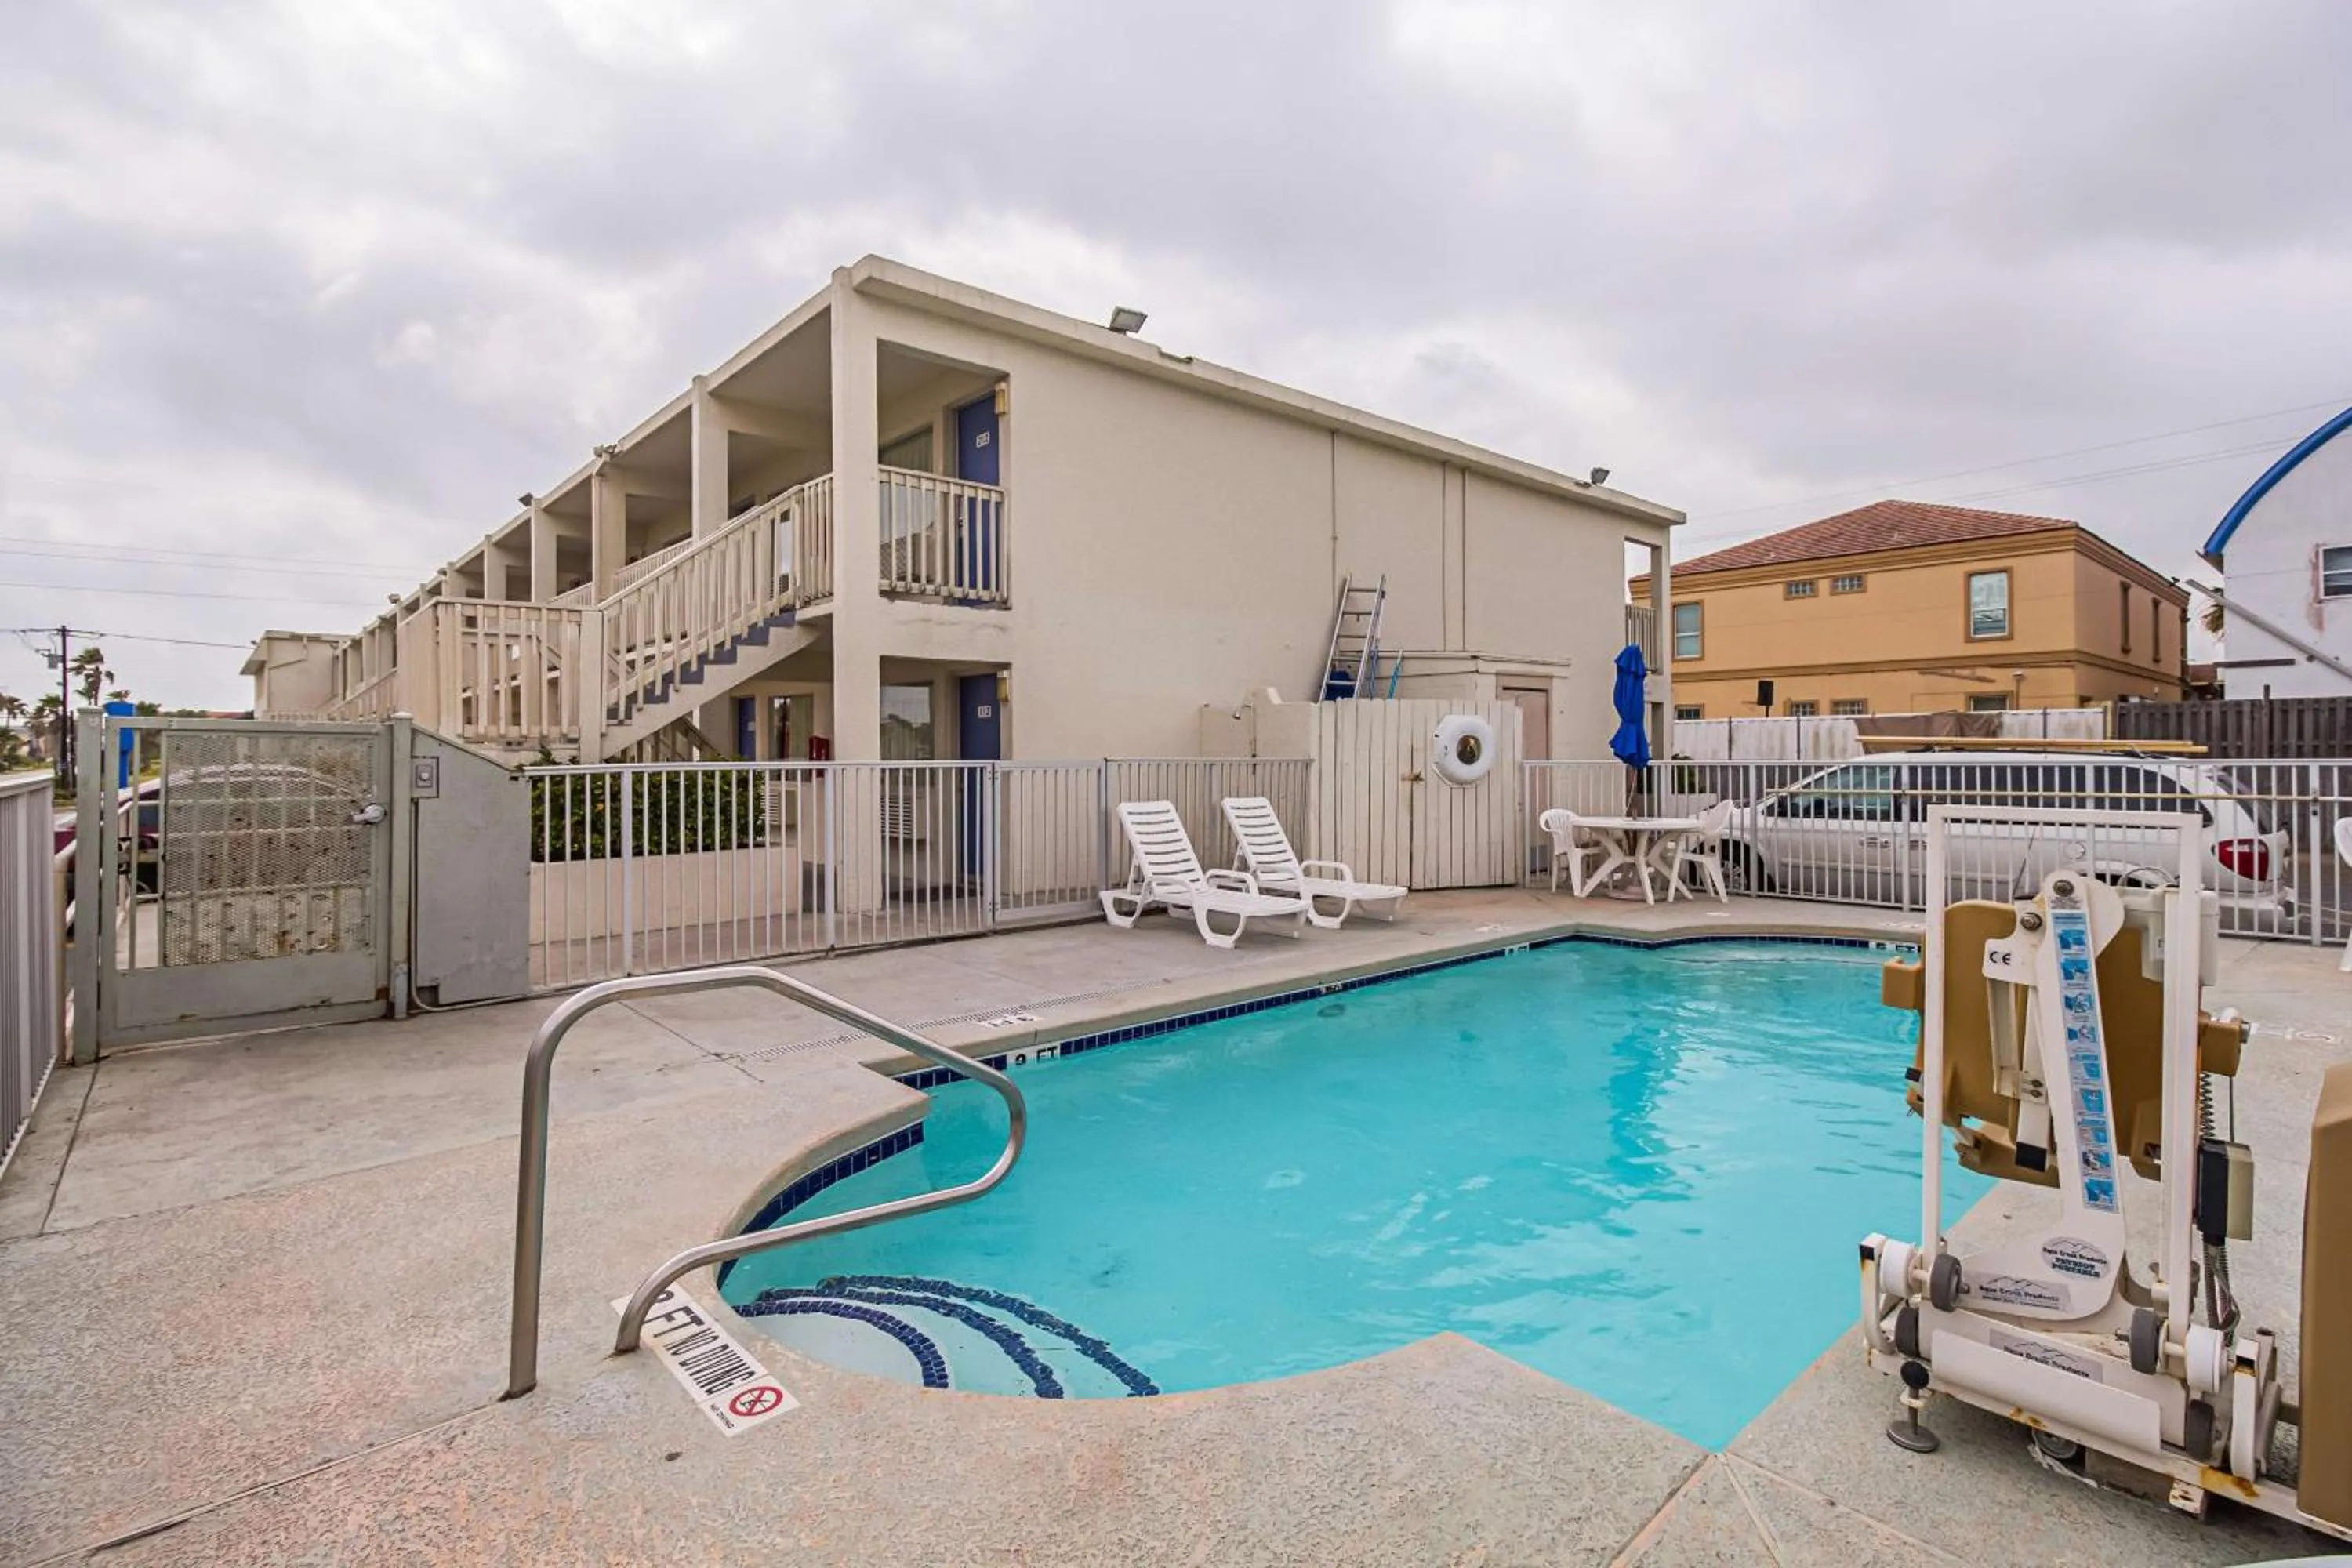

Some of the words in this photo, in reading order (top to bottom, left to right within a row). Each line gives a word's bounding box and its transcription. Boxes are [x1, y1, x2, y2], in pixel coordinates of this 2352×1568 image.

[1989, 950, 2012, 966] CE
[1036, 1045, 1058, 1063] FT
[642, 1305, 706, 1338] FT
[664, 1327, 720, 1356] NO
[678, 1342, 756, 1396] DIVING
